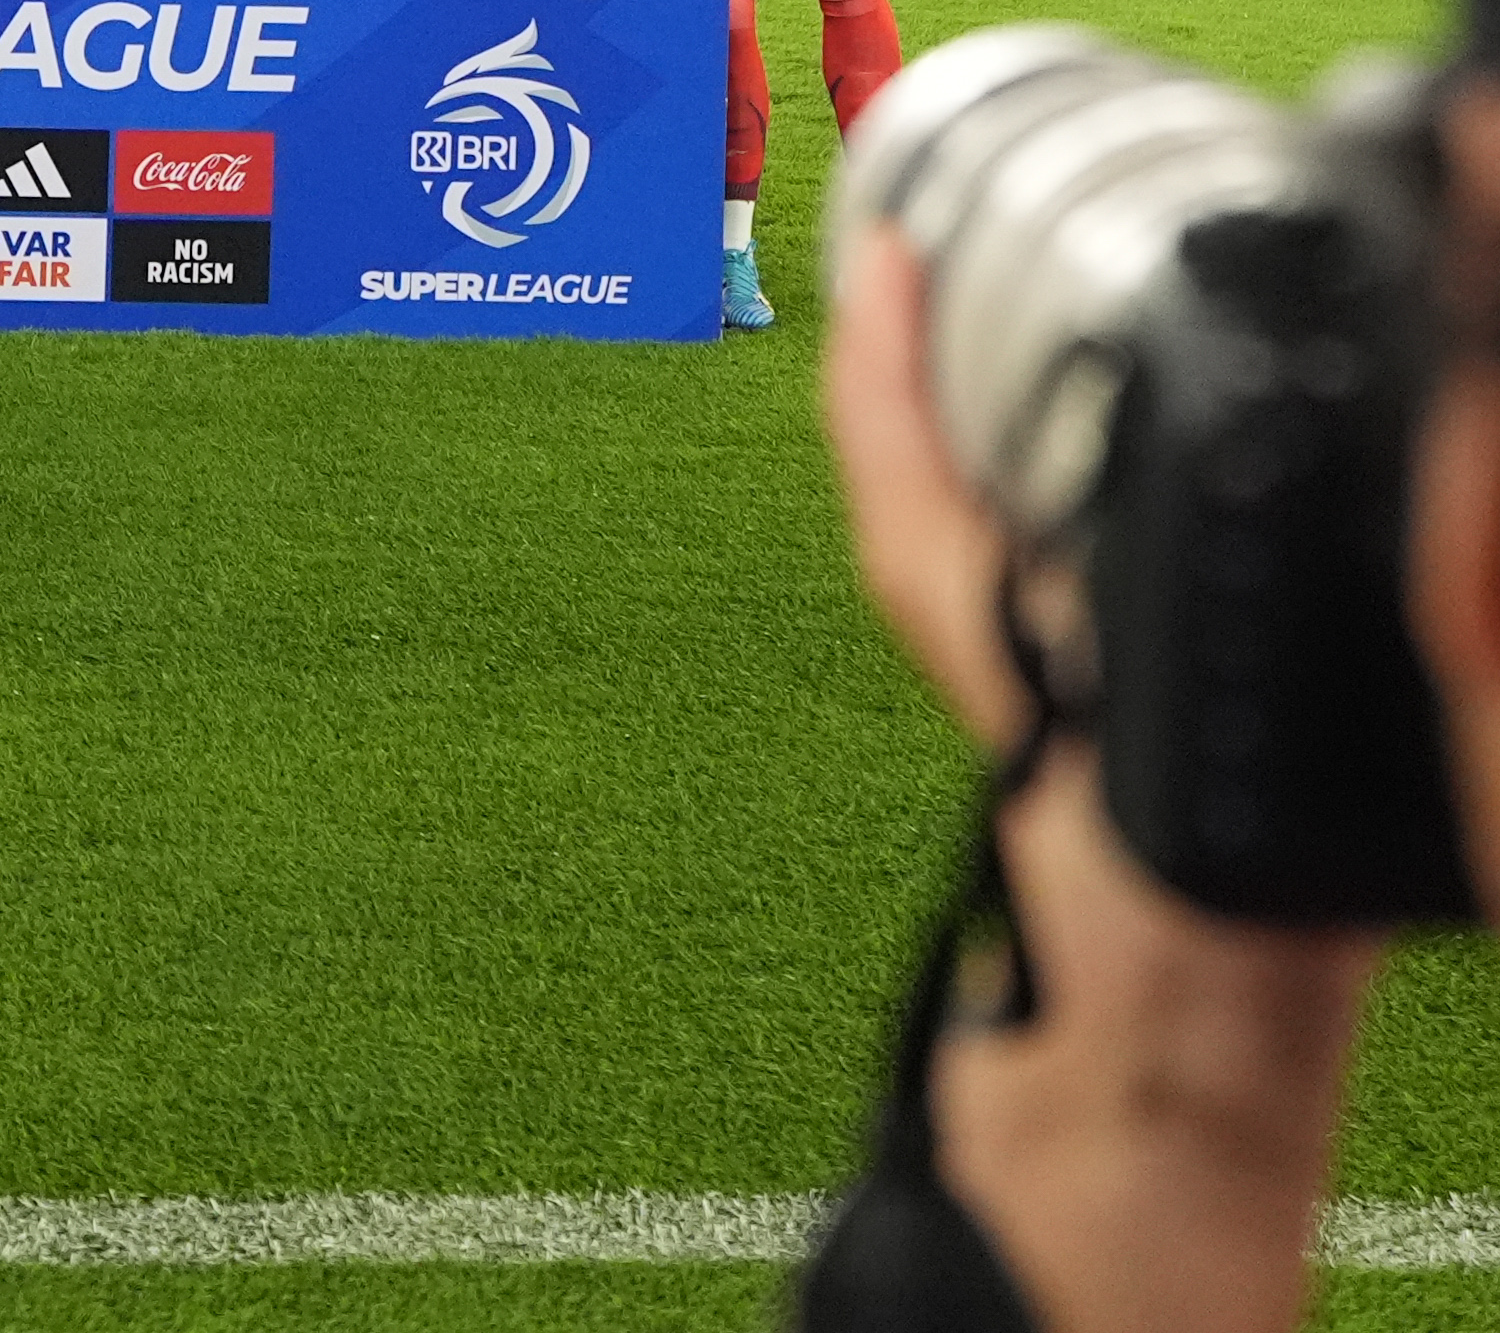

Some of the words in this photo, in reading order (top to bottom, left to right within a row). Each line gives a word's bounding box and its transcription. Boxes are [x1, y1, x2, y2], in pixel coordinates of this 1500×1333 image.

[457, 135, 518, 171] BRI
[132, 151, 253, 193] Coca-Cola
[174, 238, 209, 261] NO
[147, 261, 235, 285] RACISM
